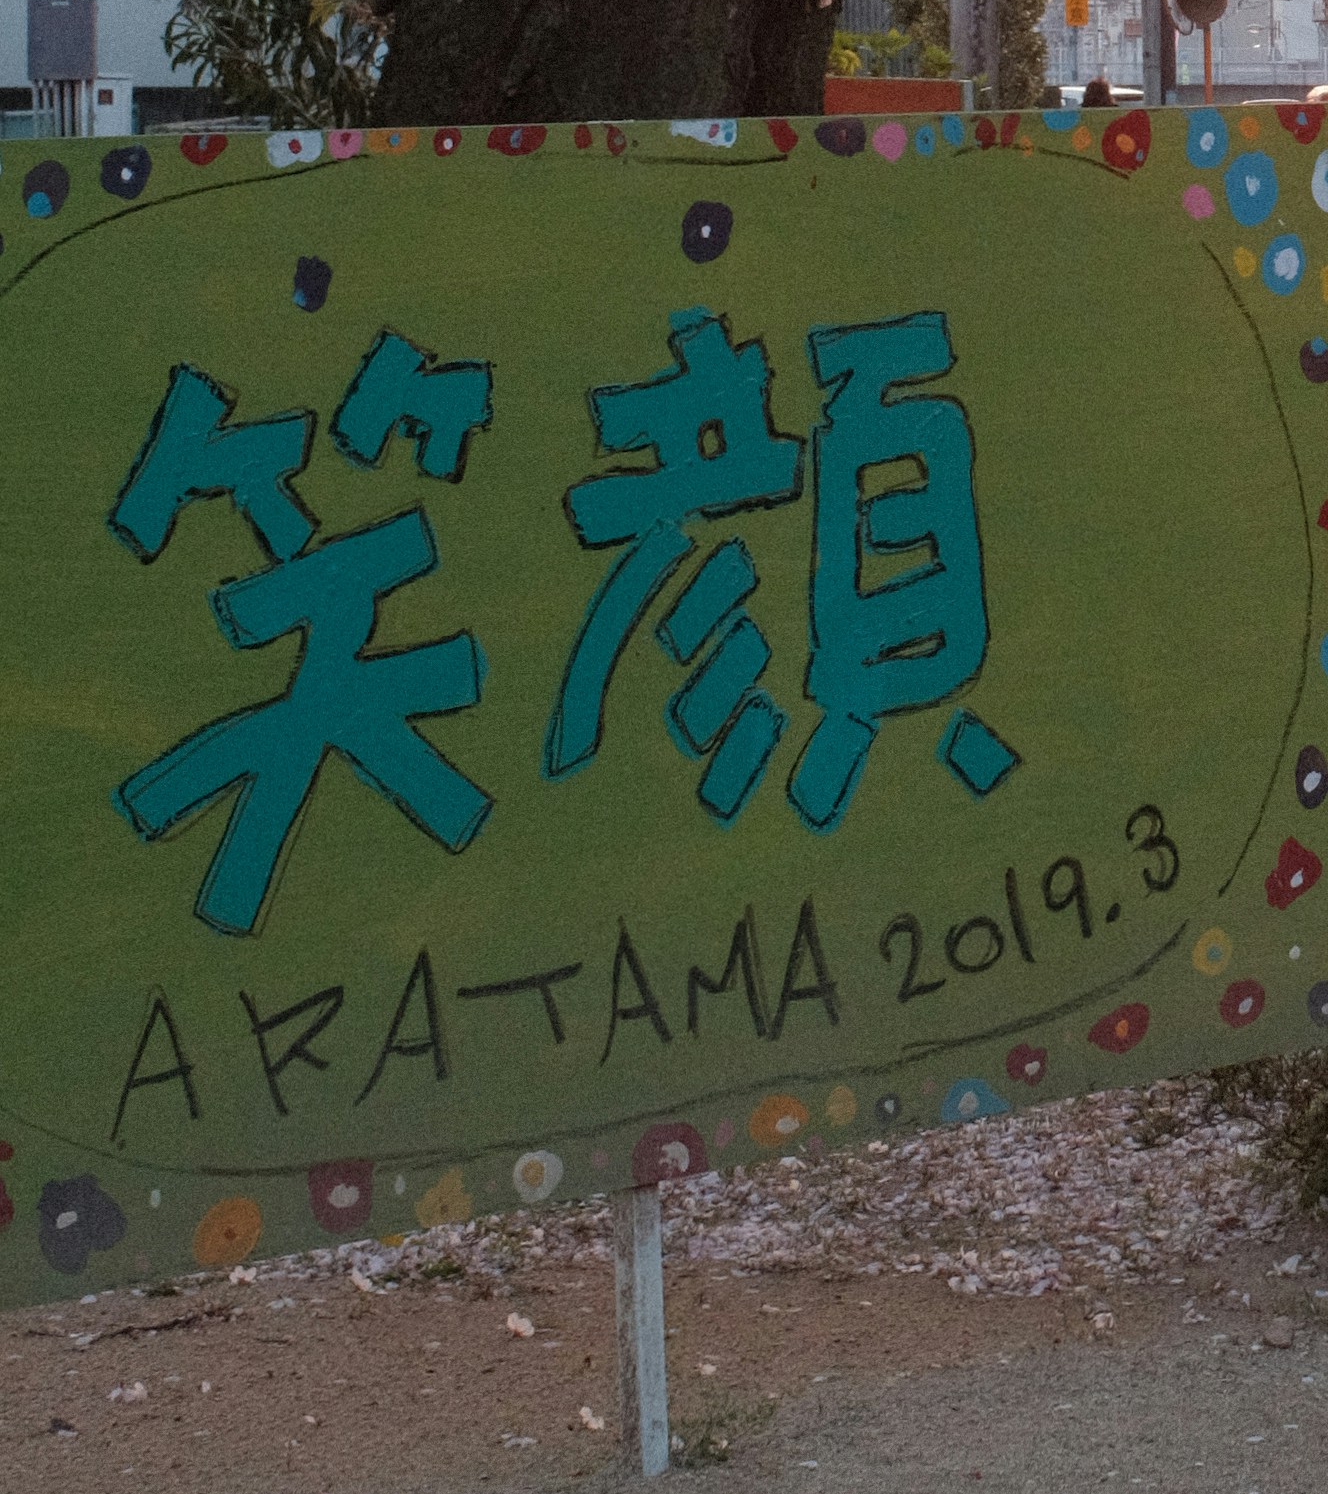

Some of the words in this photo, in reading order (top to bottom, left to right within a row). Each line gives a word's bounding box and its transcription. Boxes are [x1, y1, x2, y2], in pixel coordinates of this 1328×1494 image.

[106, 306, 1021, 938] 笑顔
[108, 896, 842, 1150] ARATAMA
[878, 803, 1183, 1005] 2019.3
